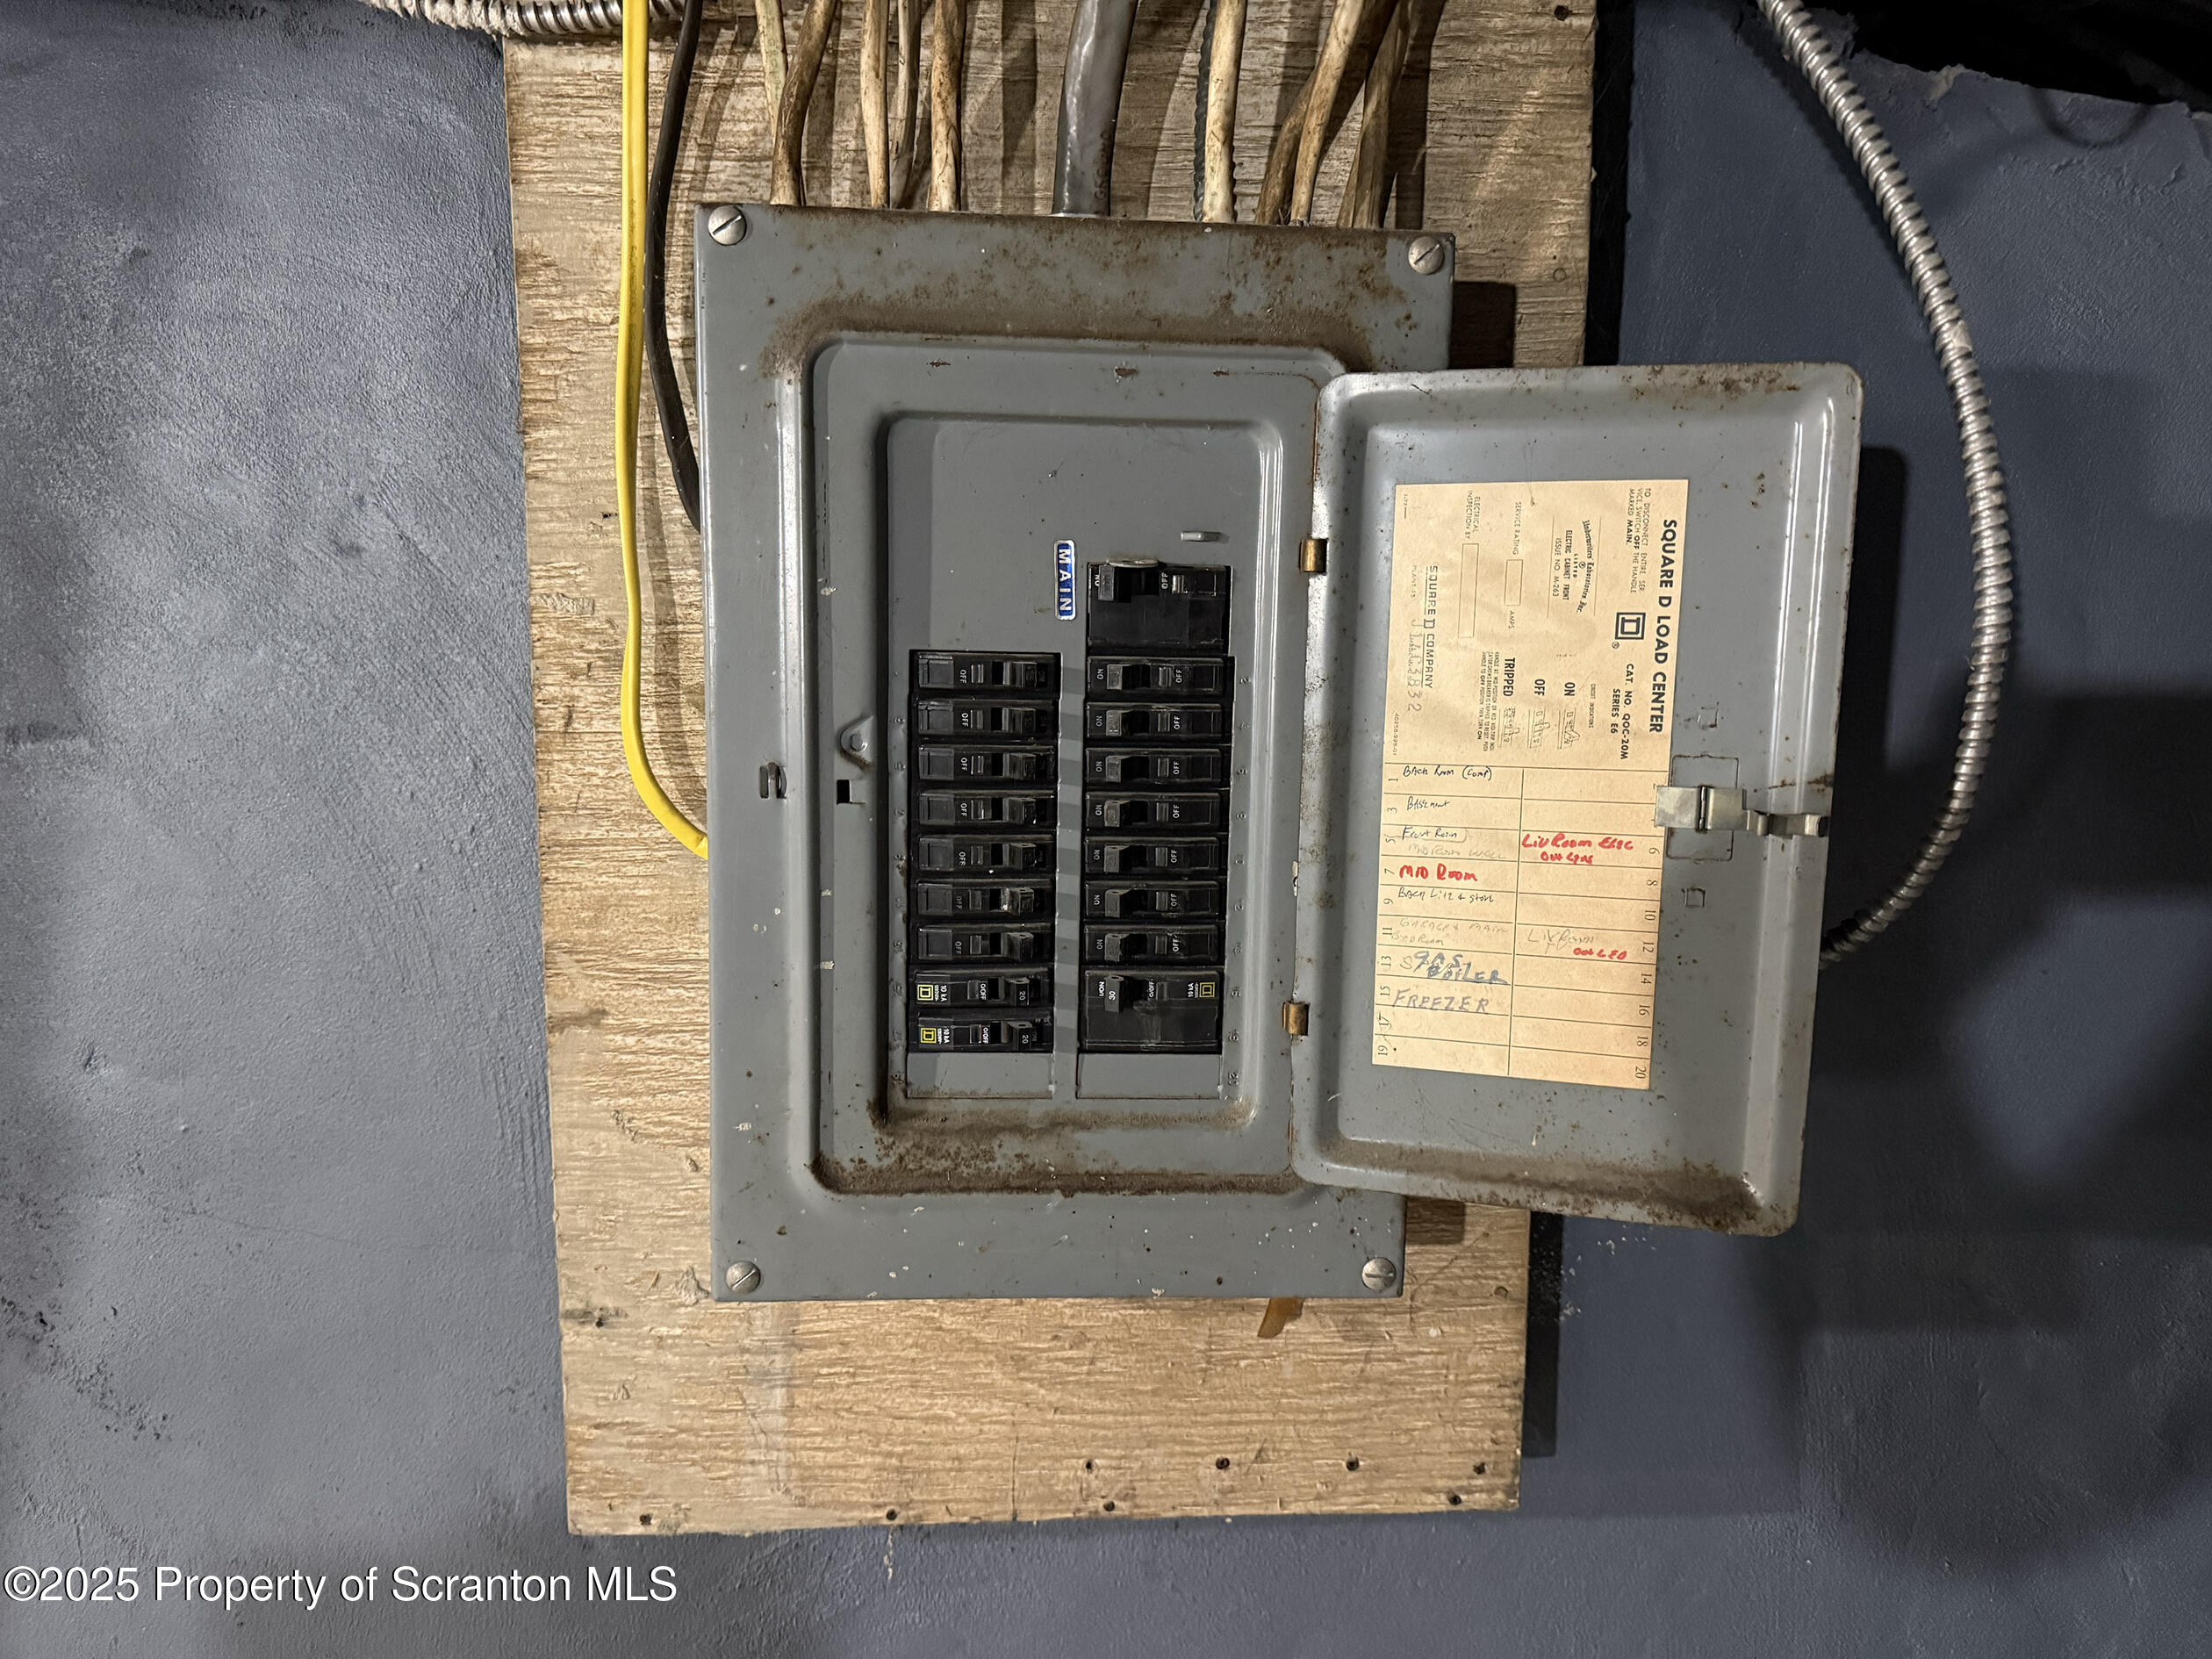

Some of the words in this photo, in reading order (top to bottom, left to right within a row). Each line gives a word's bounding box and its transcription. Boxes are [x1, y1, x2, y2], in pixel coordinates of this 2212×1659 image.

[1644, 488, 1651, 497] TO
[1513, 501, 1522, 527] SERVICE
[1641, 503, 1650, 546] DISCONNECT
[1660, 519, 1677, 588] SQUARE
[1059, 549, 1072, 611] MAIN
[1630, 566, 1639, 594] HANDLE
[1427, 565, 1438, 615] SQUARE
[1658, 596, 1672, 607] D
[1424, 618, 1436, 628] D
[1654, 615, 1670, 664] LOAD
[1425, 633, 1435, 688] COMPANY
[1097, 668, 1104, 679] ON
[1503, 657, 1516, 697] TRIPPED
[1625, 664, 1634, 686] CAT.
[1534, 679, 1546, 696] OFF
[1564, 682, 1576, 697] ON
[1612, 688, 1620, 718] SERIES
[1623, 690, 1632, 708] NO.
[1649, 672, 1666, 733] CENTER
[1096, 715, 1102, 727] ON
[1610, 722, 1619, 734] E6
[1620, 714, 1631, 760] QOC-20M
[1095, 761, 1102, 772] ON
[1095, 804, 1102, 815] ON
[1094, 849, 1100, 860] ON
[1094, 894, 1100, 905] ON
[1645, 909, 1656, 921] 10
[1097, 939, 1103, 950] ON
[1643, 941, 1655, 952] 12
[1382, 955, 1391, 966] 13
[1641, 973, 1652, 984] 14
[1019, 990, 1026, 1001] 20
[1109, 990, 1116, 1001] 30
[1380, 986, 1390, 996] 15
[1392, 987, 1490, 1013] FREEZER
[1639, 1004, 1650, 1016] 16
[1022, 1034, 1029, 1045] 20
[1636, 1036, 1648, 1046] 18
[1378, 1045, 1388, 1056] 19
[1635, 1066, 1647, 1079] 20
